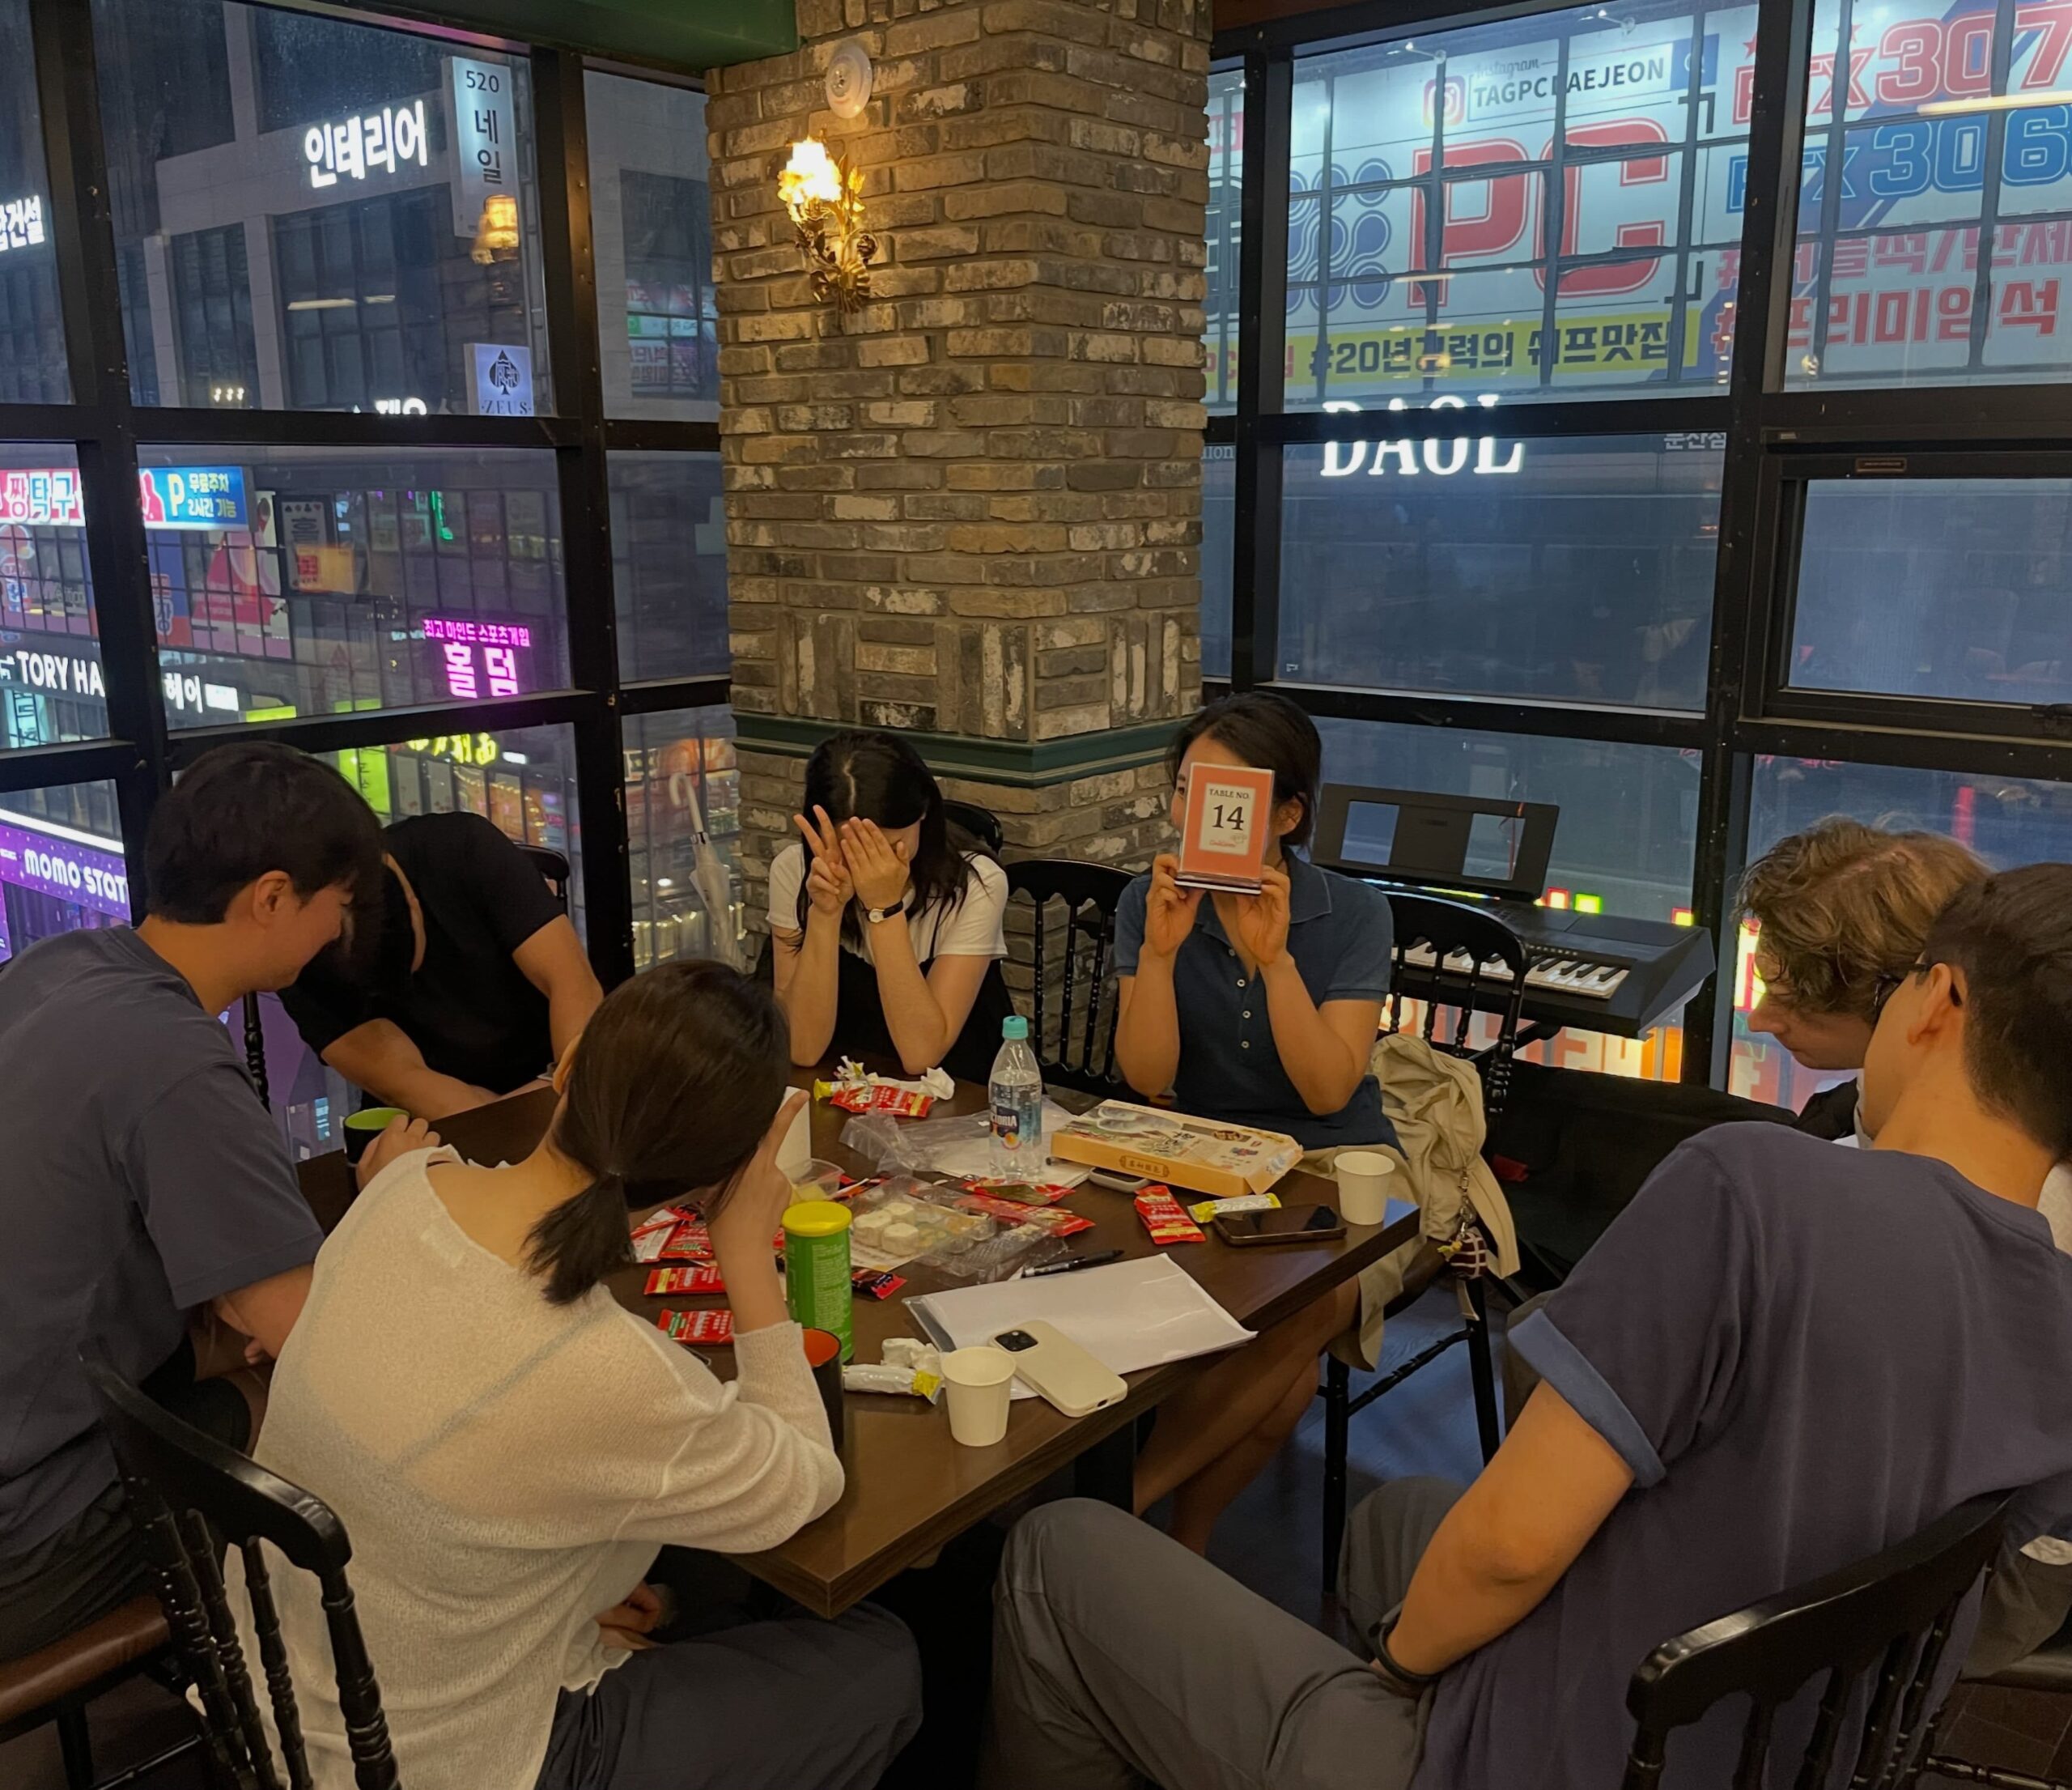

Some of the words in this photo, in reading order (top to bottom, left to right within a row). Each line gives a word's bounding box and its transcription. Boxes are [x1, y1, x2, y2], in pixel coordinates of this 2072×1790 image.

[466, 70, 499, 93] 520
[1473, 57, 1664, 108] TAGPCAEJEON
[304, 98, 427, 189] 인테리어
[474, 109, 502, 185] 네일
[1408, 117, 1669, 308] PC
[484, 399, 528, 415] ZEUS
[168, 474, 185, 517] P
[187, 497, 214, 518] 2시간
[16, 650, 68, 691] TORY
[1209, 789, 1234, 797] TABLE
[1212, 804, 1244, 831] 14
